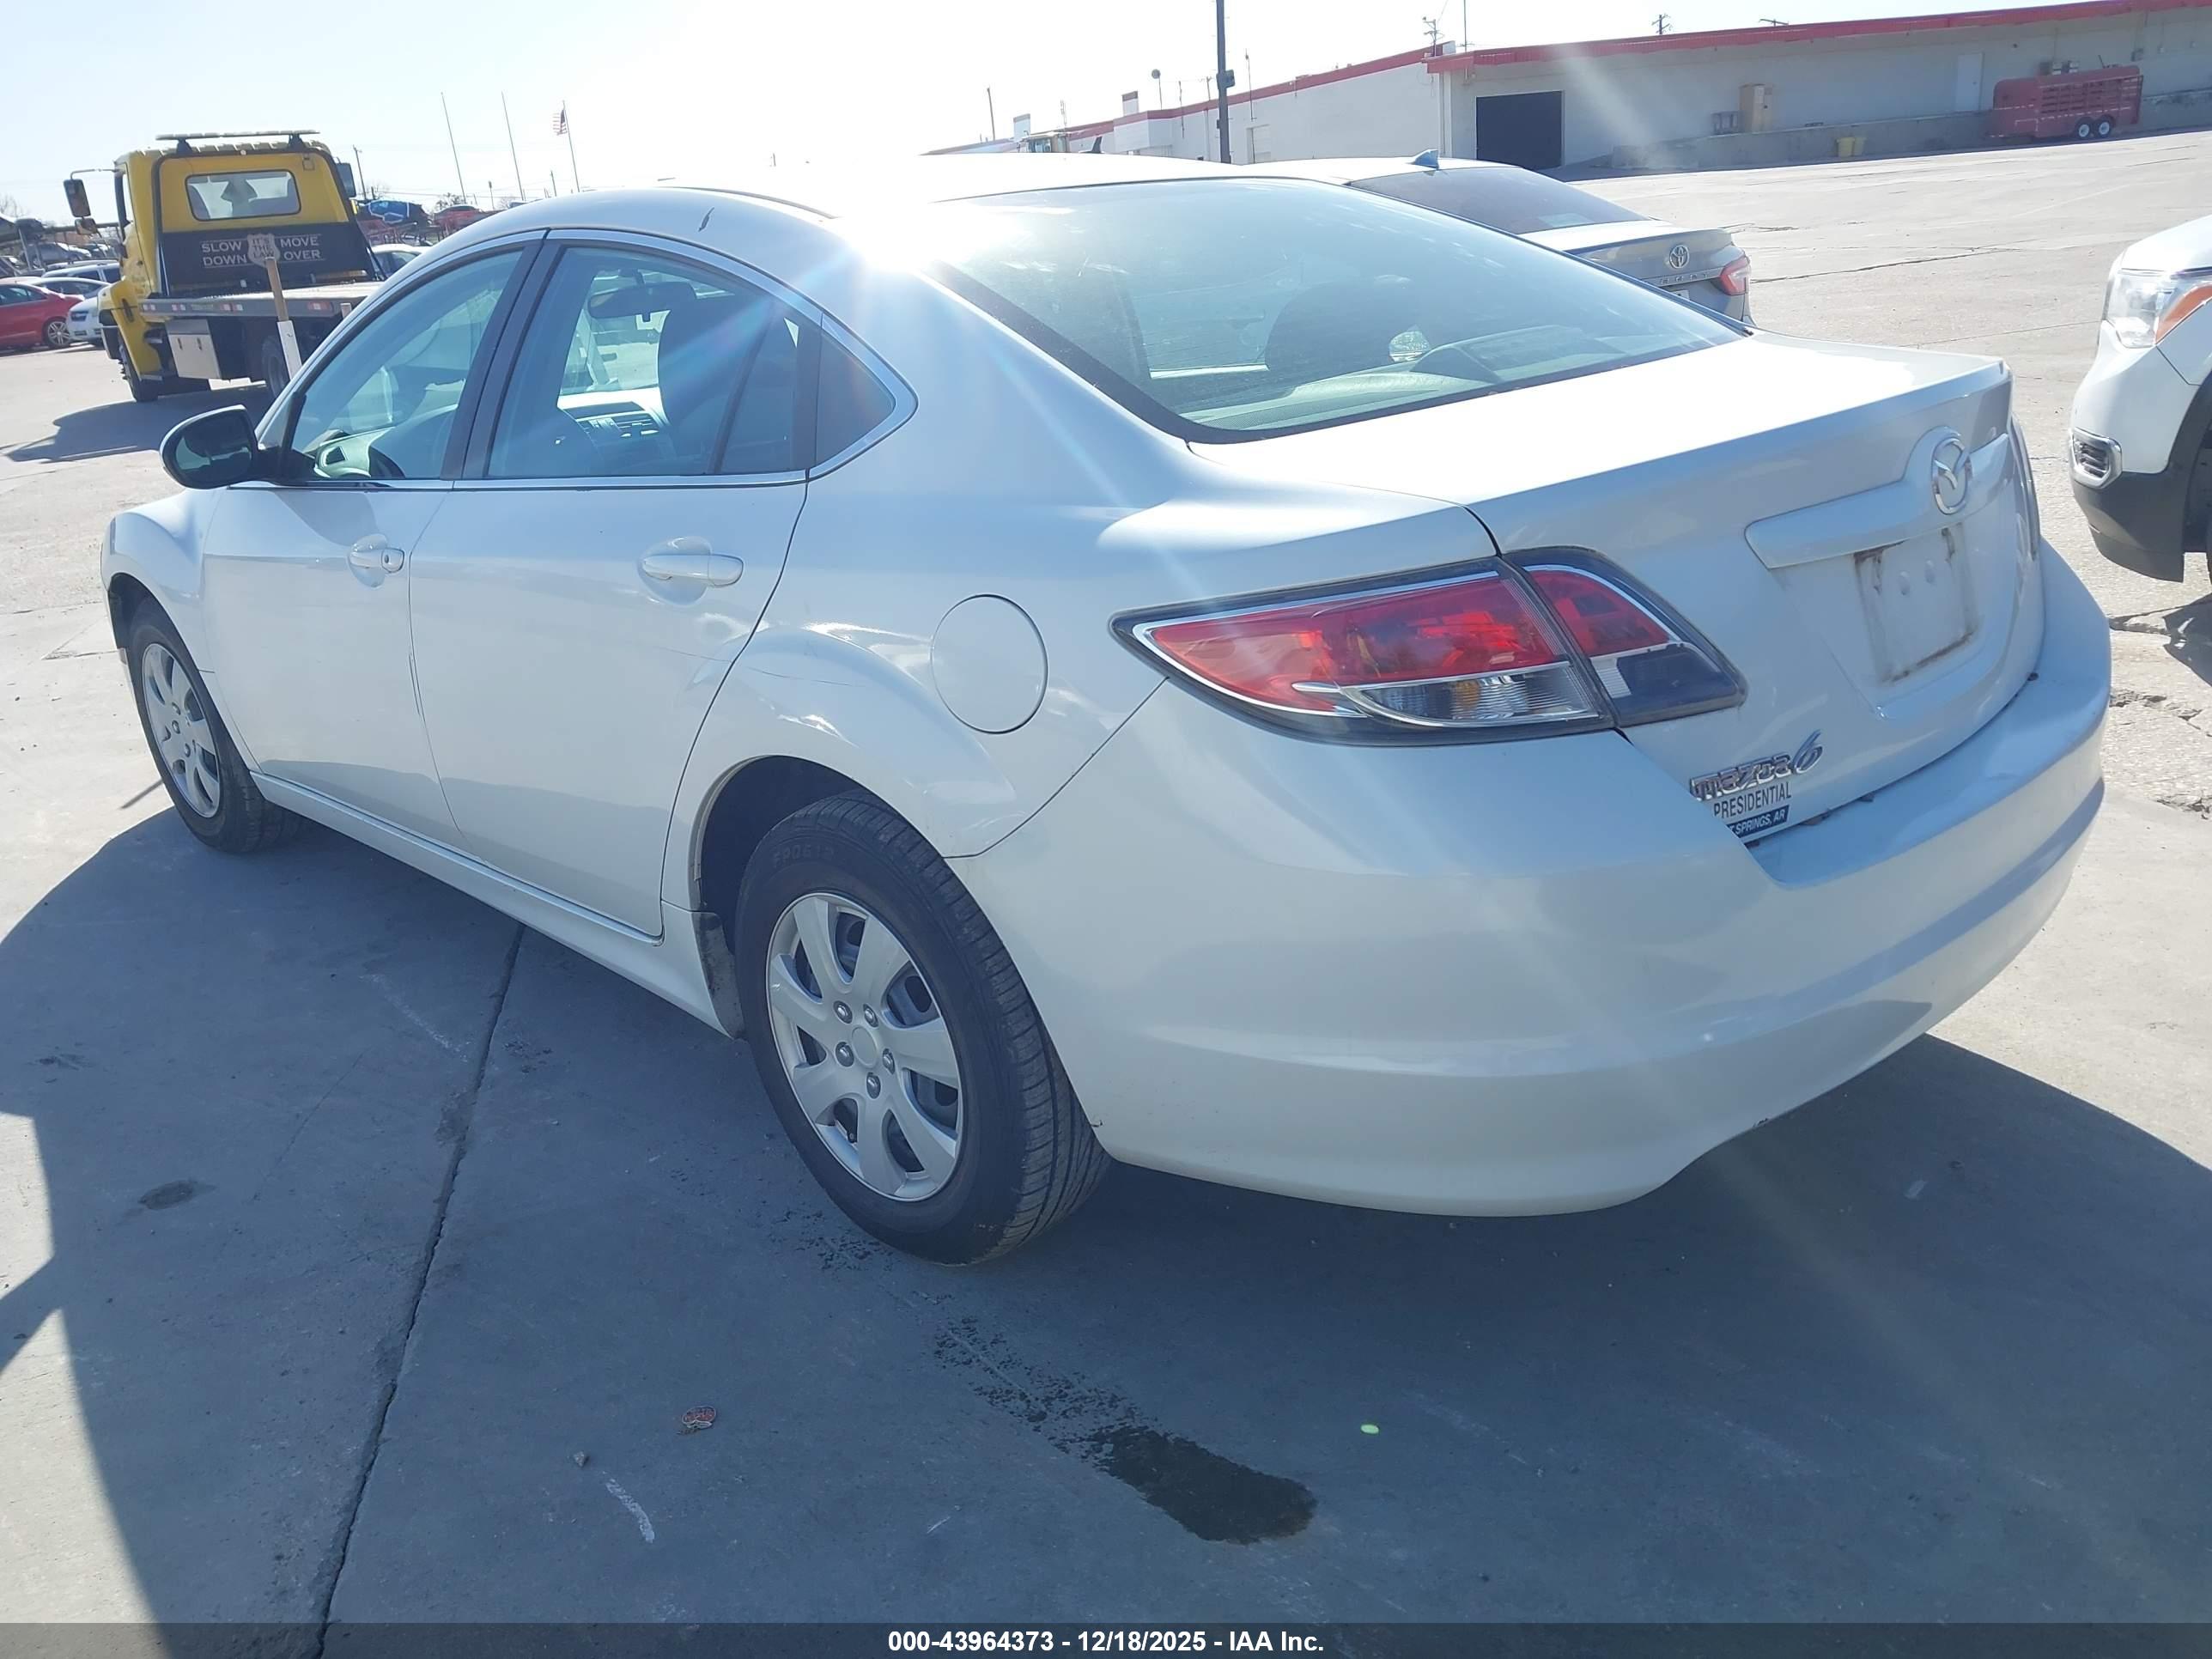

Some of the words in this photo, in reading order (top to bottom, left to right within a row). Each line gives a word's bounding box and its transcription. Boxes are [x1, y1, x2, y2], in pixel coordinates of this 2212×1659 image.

[201, 240, 241, 252] SLOW
[280, 236, 319, 247] MOVE
[202, 254, 247, 267] DOWN
[283, 249, 321, 260] OVER
[1713, 781, 1792, 819] PRESIDENTIAL
[1735, 812, 1772, 835] SPRINGS,
[1772, 809, 1785, 823] AR
